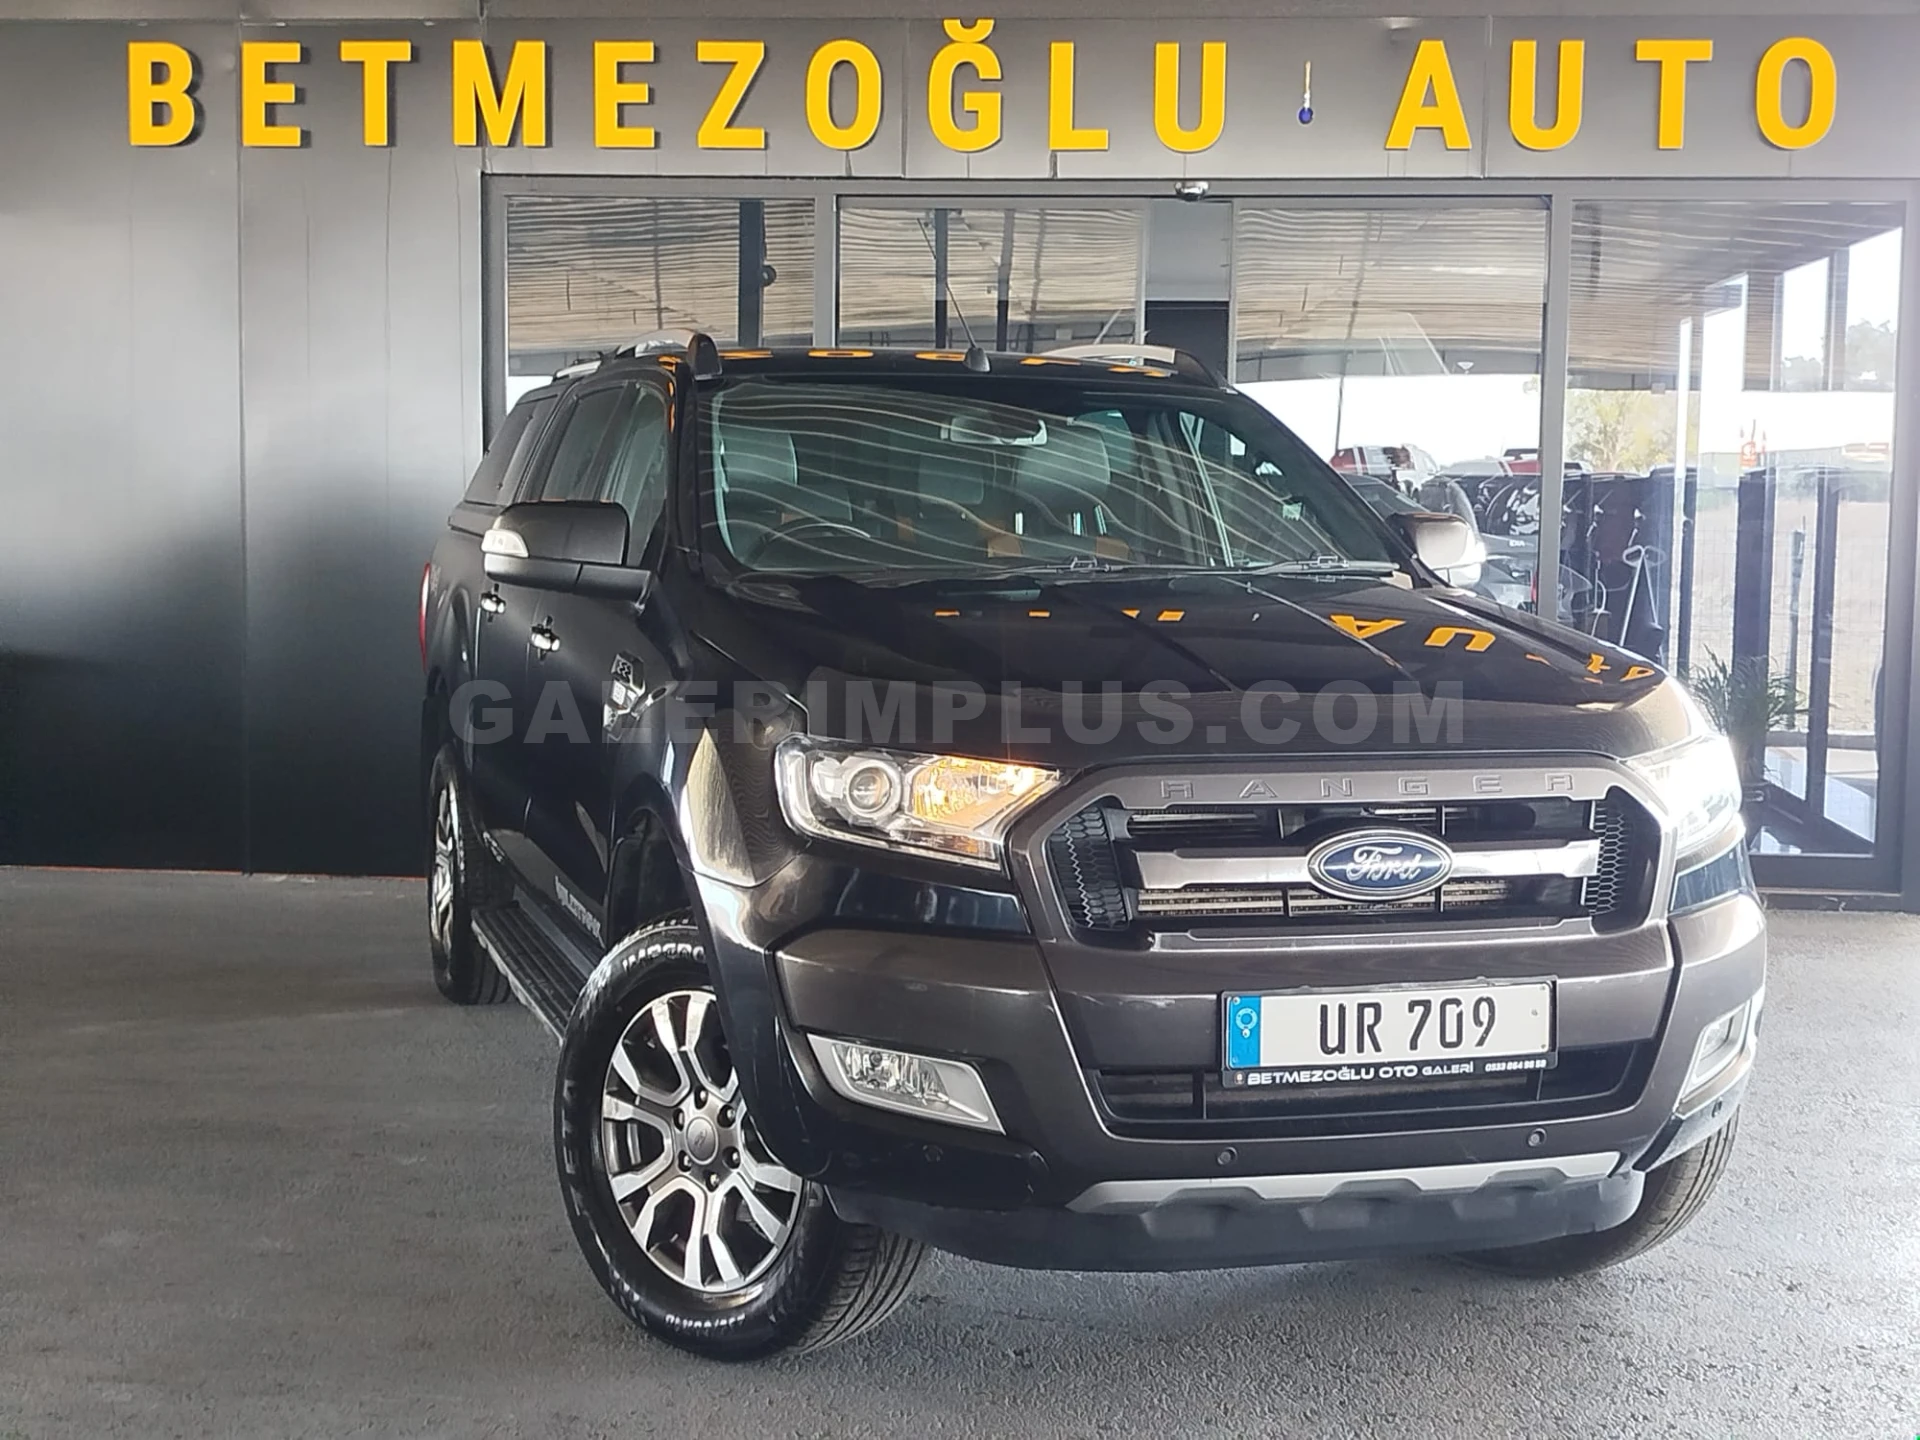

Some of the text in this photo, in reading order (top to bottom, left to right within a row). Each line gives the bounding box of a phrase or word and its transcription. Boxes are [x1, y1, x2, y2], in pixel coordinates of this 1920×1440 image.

[127, 18, 1837, 151] BETMEZOĞLU AUTO
[1160, 773, 1574, 799] RANGER
[1345, 845, 1422, 882] Ford
[1319, 996, 1497, 1056] UR 709
[1247, 1066, 1374, 1086] BETMEZOĞLU
[1379, 1065, 1418, 1079] OTO
[1422, 1061, 1474, 1076] GALERİ
